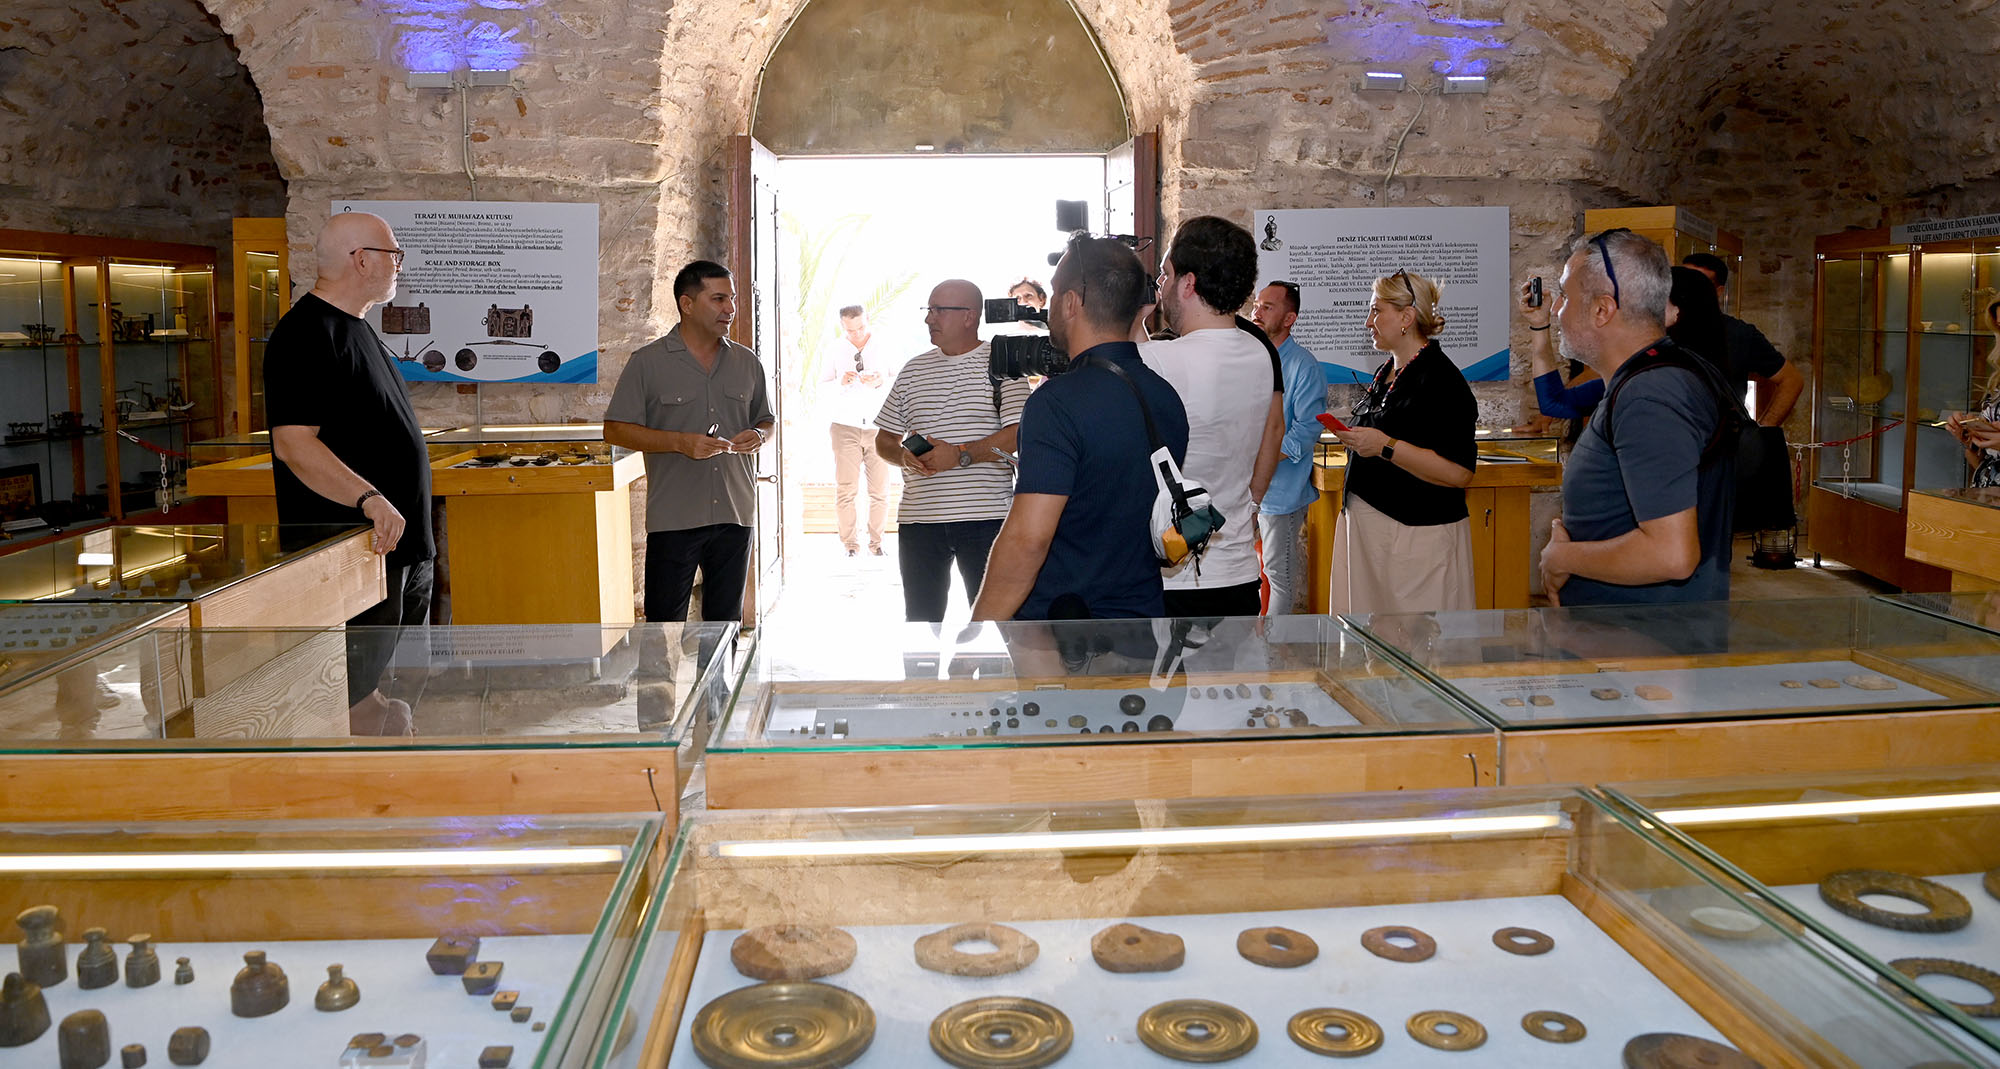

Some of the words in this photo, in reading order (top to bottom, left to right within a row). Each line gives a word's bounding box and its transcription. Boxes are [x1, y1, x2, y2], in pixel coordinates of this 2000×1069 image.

[1907, 225, 1921, 233] DENİZ
[1948, 221, 1954, 229] VE
[1913, 234, 1921, 242] SEA
[1933, 233, 1942, 241] AND
[1952, 230, 1969, 239] IMPACT
[1970, 229, 1978, 237] ON
